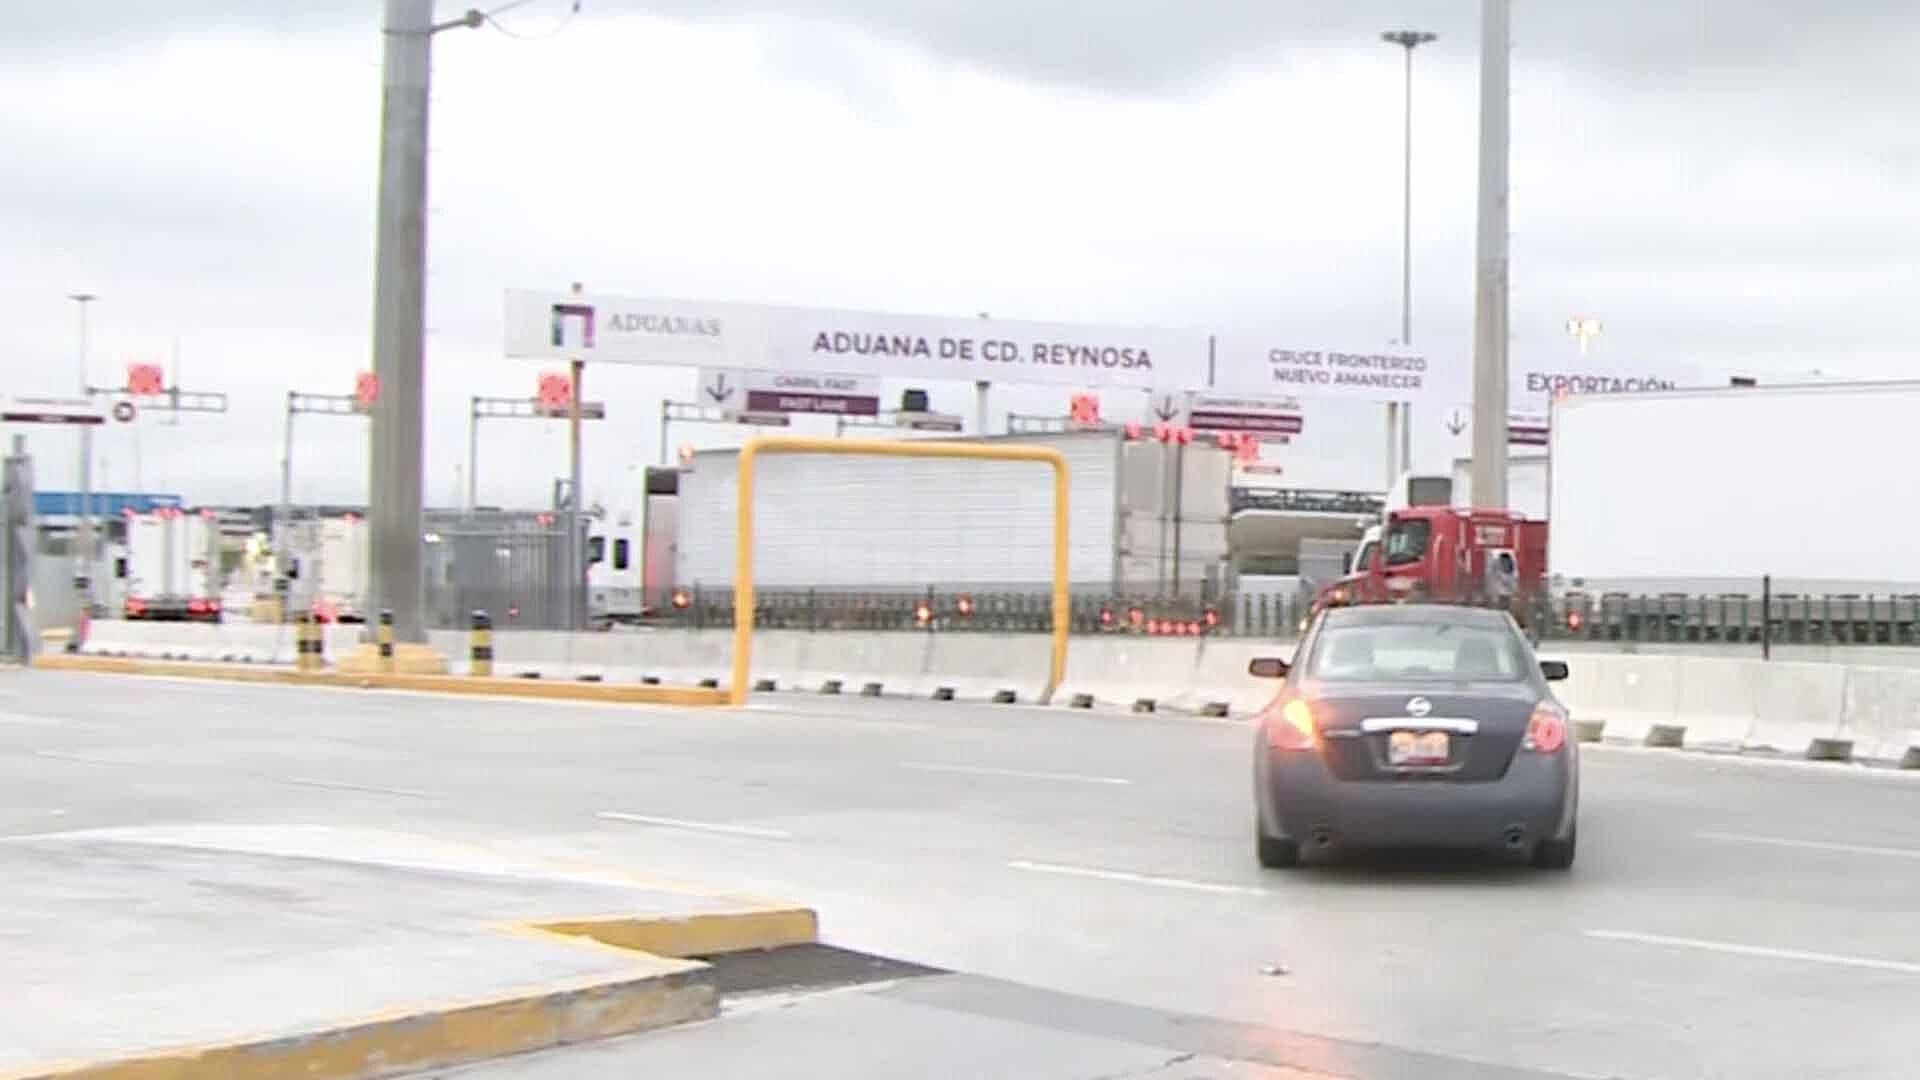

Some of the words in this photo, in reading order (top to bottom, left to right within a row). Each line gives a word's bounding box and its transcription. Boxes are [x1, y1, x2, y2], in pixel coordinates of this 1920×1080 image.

[608, 313, 721, 337] ADUANAS
[812, 331, 930, 358] ADUANA
[938, 338, 974, 360] DE
[981, 340, 1025, 362] CD.
[1032, 344, 1153, 369] REYNOSA
[1269, 348, 1323, 366] CRUCE
[1328, 351, 1428, 372] FRONTERIZO
[1273, 367, 1331, 384] NUEVO
[1333, 372, 1423, 389] AMANECER
